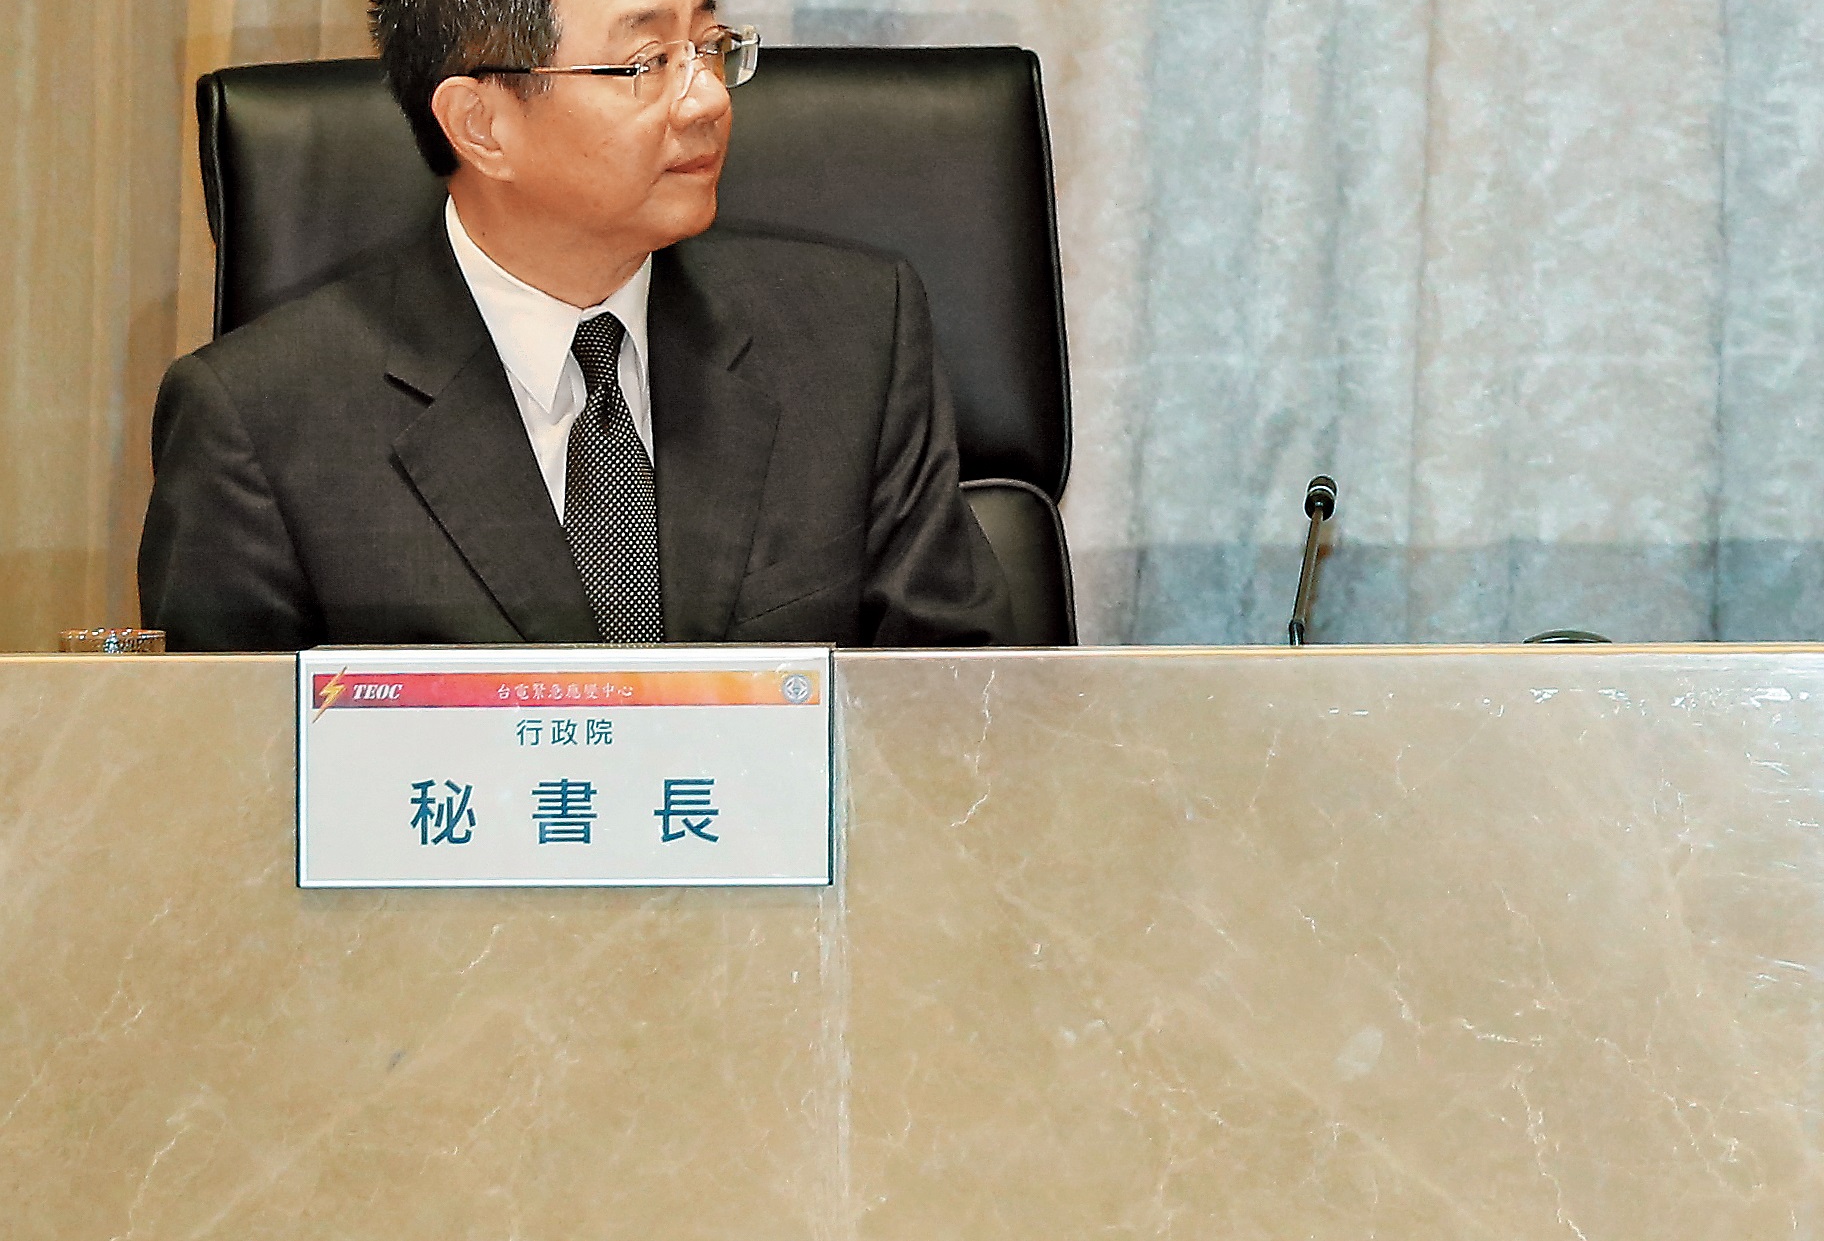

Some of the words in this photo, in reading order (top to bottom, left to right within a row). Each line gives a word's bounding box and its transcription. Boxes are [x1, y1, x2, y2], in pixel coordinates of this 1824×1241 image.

[352, 682, 403, 701] TEOC
[516, 718, 614, 746] 行政院
